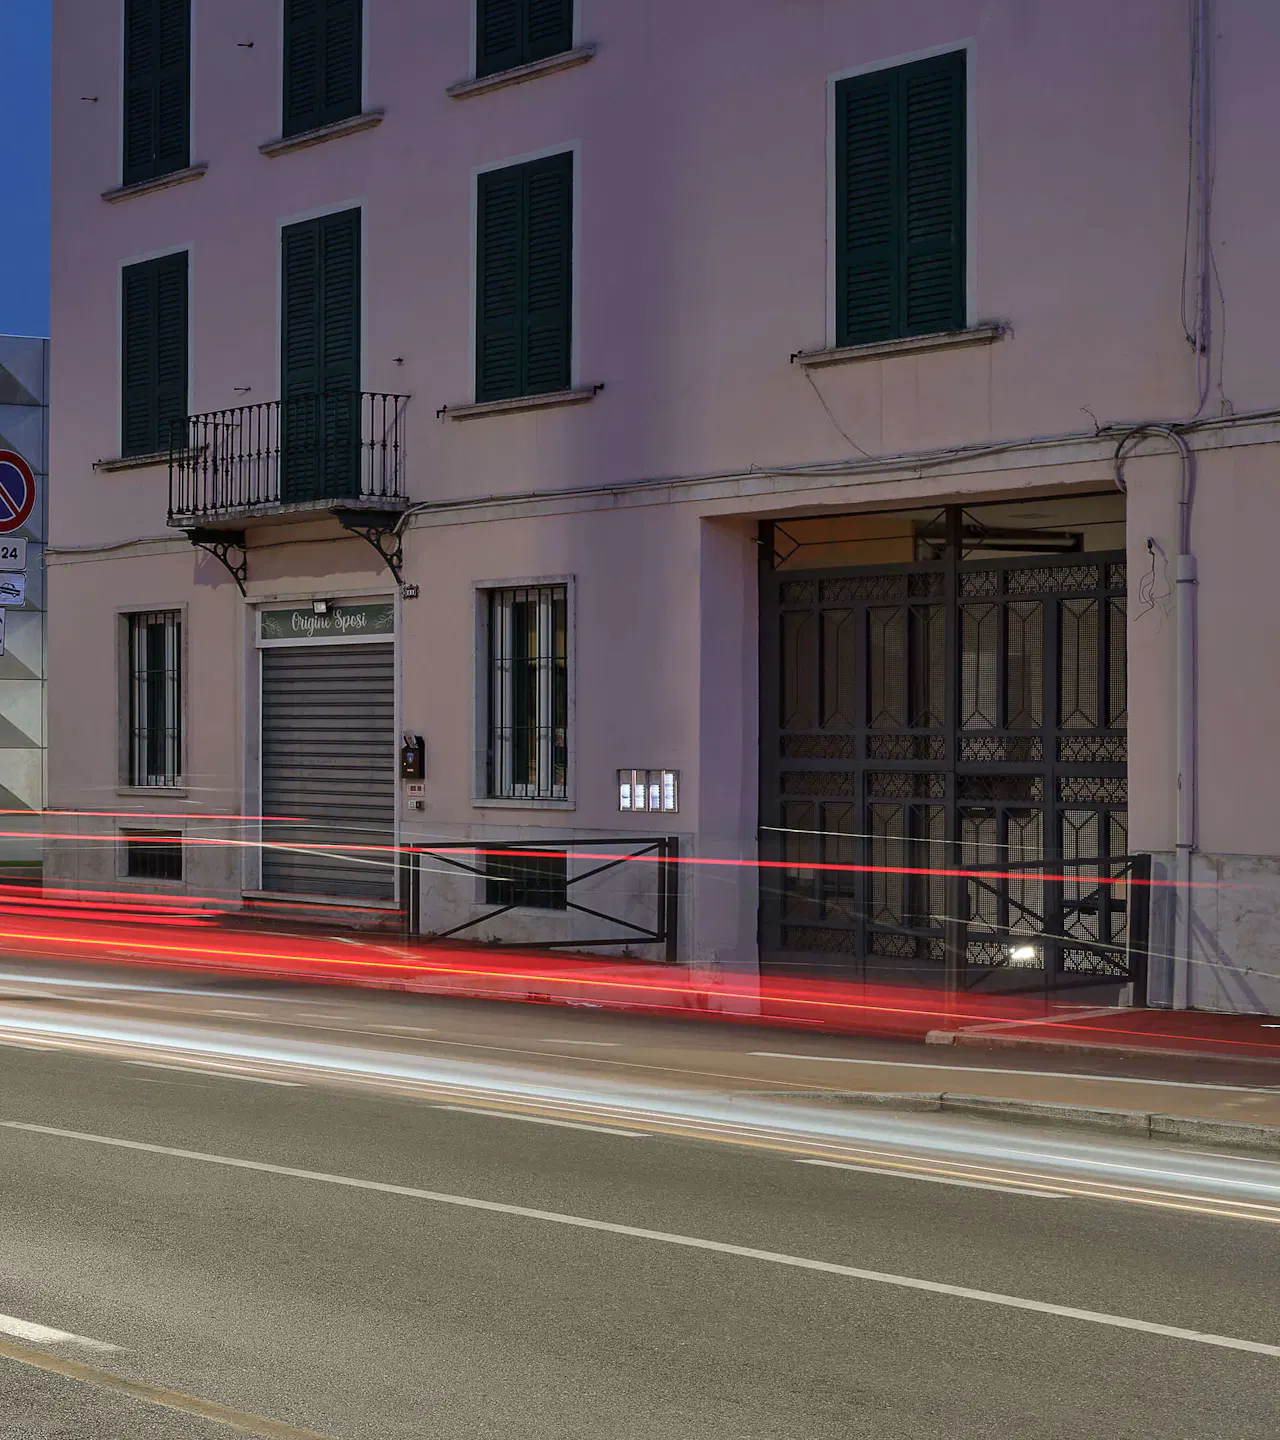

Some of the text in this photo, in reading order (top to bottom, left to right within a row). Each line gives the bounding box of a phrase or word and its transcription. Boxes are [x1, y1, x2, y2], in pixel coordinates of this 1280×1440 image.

[1, 546, 18, 559] 24
[292, 610, 368, 637] Origine Sposi
